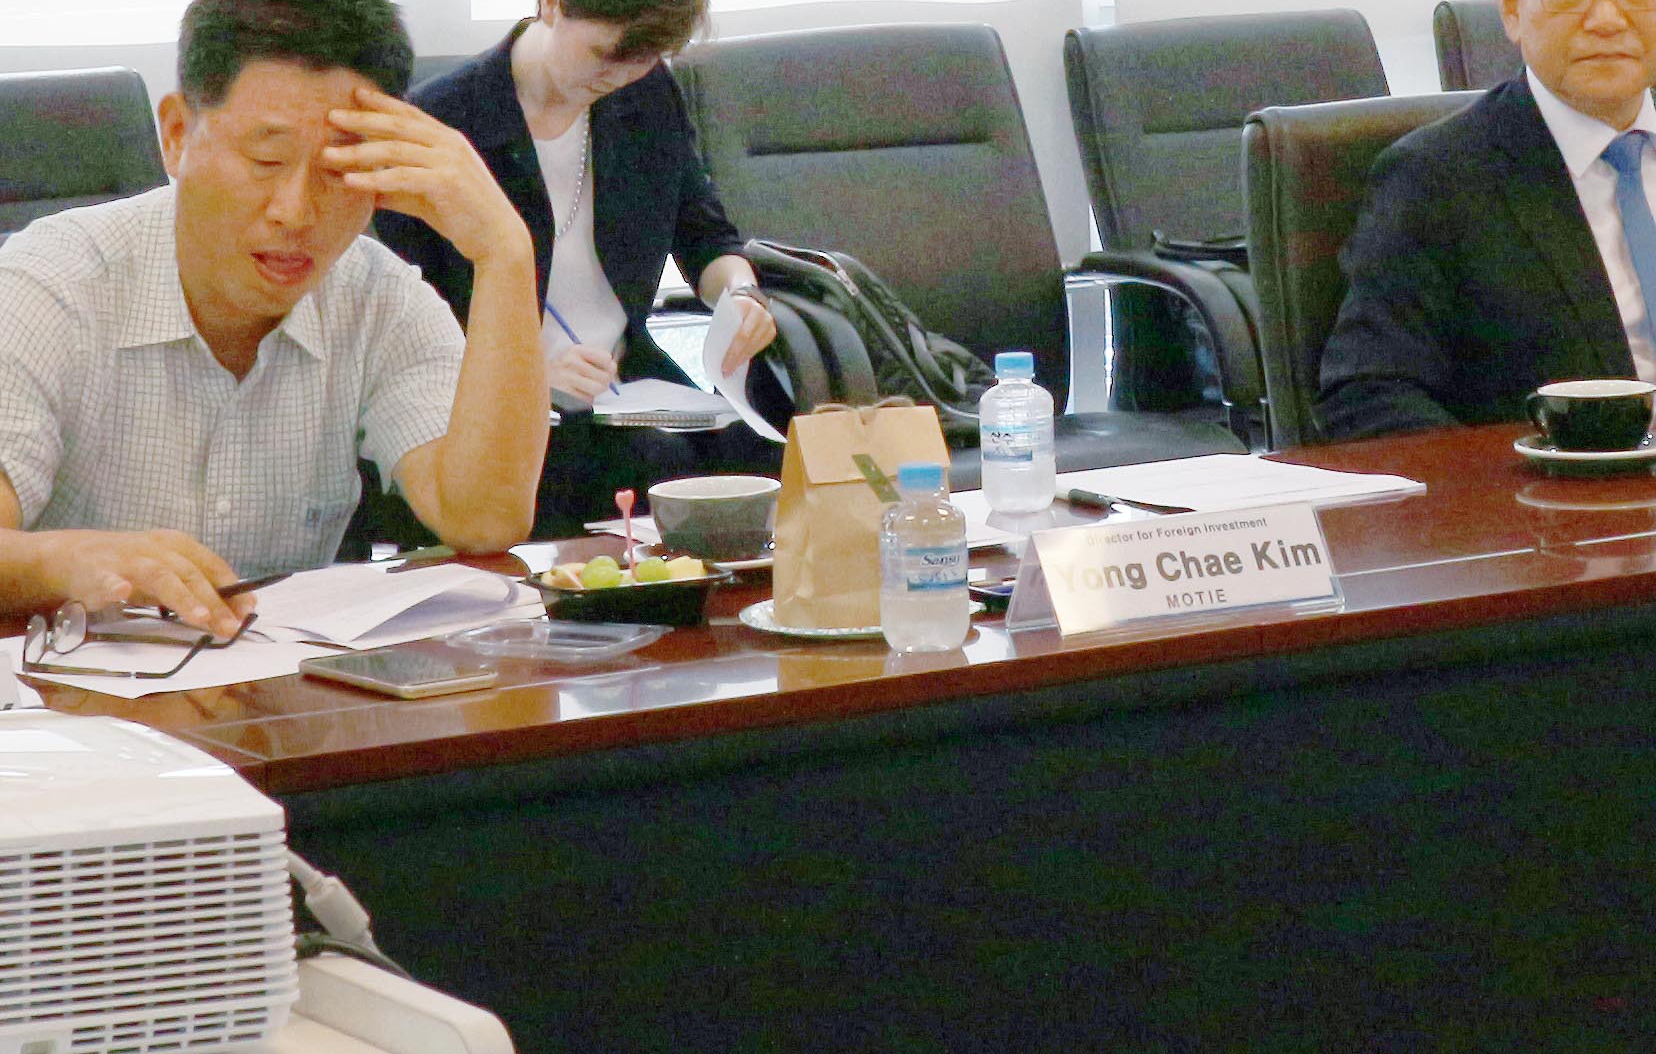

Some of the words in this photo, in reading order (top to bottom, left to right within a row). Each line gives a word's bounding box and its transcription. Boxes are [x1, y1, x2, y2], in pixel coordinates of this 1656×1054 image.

[1137, 529, 1154, 543] for
[1157, 524, 1203, 540] Foreign
[1204, 516, 1269, 534] Investment
[1053, 560, 1148, 593] Yong
[1155, 549, 1244, 583] Chae
[1250, 538, 1323, 572] Kim
[1165, 588, 1228, 610] MOTIE
